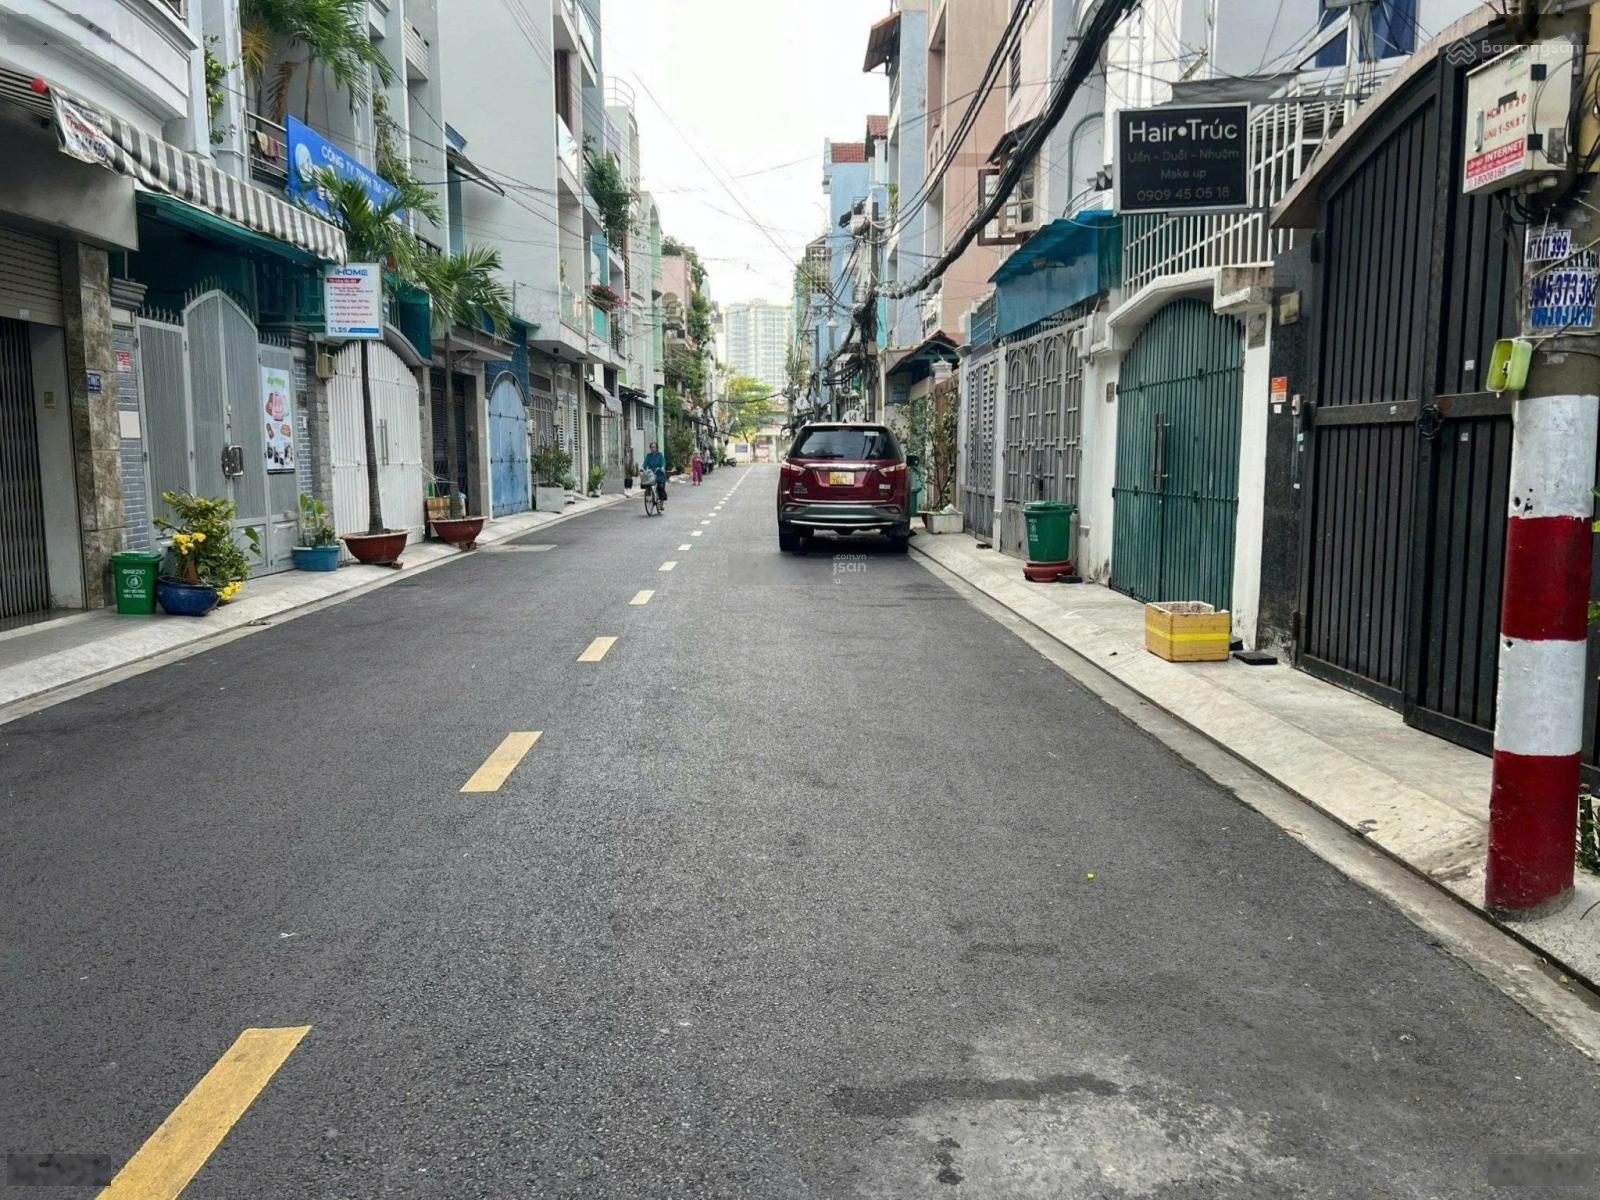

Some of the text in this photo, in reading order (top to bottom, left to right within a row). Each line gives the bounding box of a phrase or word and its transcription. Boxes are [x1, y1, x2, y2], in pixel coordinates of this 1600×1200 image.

[1129, 118, 1238, 143] Hair Trúc
[1484, 140, 1522, 161] INTERNET
[1160, 168, 1207, 180] Make up
[1137, 186, 1230, 202] 0909 45 05 18
